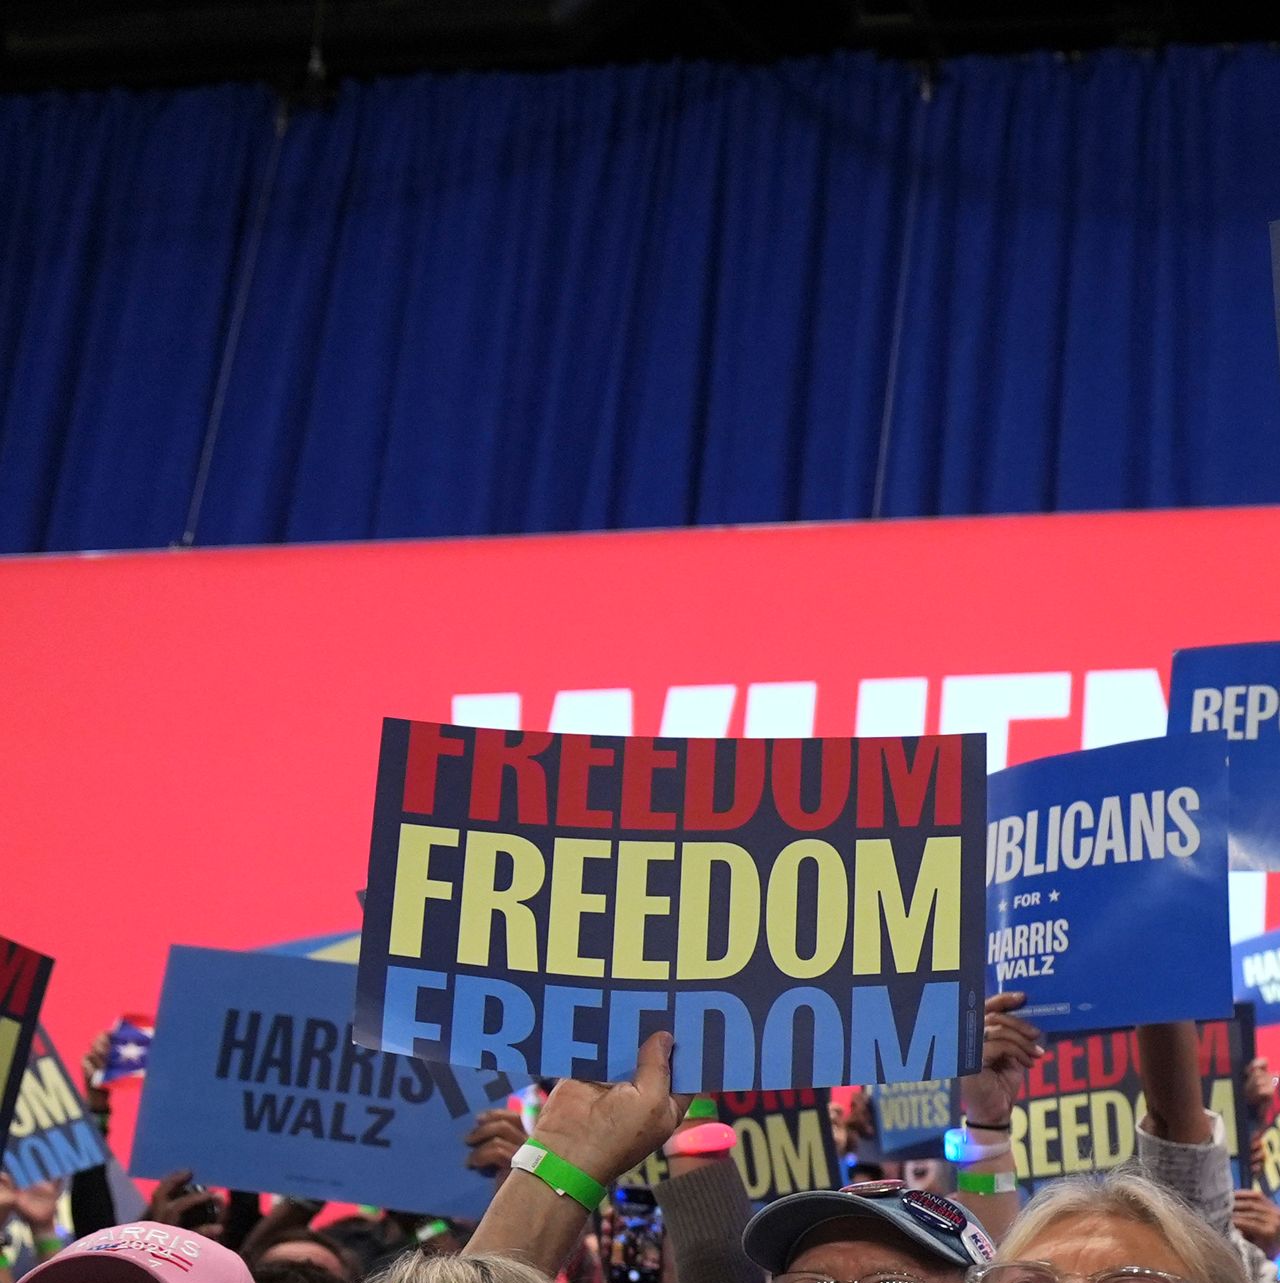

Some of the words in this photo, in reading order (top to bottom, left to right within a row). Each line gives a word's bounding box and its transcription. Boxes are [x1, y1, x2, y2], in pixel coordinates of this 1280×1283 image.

[388, 823, 962, 980] FREEDOM
[1013, 892, 1041, 909] FOR
[987, 918, 1070, 965] HARRIS
[996, 955, 1055, 983] WALZ
[243, 1090, 396, 1148] WALZ
[880, 1092, 951, 1131] VOTES
